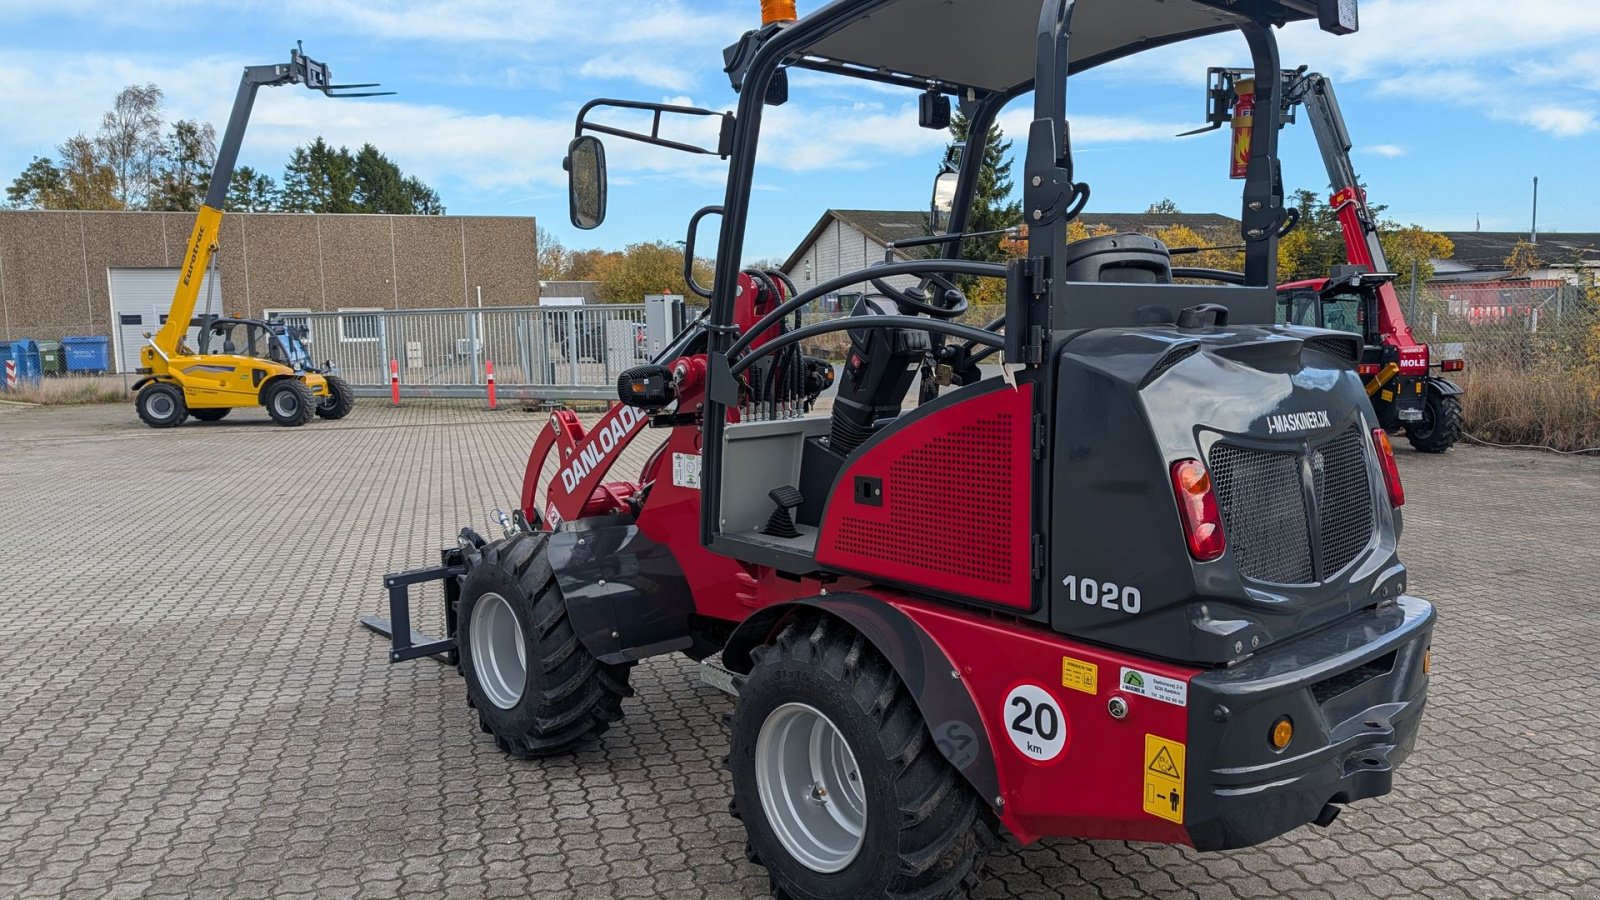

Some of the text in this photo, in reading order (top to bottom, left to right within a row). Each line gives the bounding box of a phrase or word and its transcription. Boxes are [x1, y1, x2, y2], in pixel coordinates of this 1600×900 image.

[183, 225, 204, 286] Eurotrac
[1401, 359, 1426, 367] MOLE
[1266, 410, 1331, 434] J-MASKINER.DK
[561, 404, 647, 495] DANLOADE
[1062, 575, 1140, 614] 1020
[1011, 696, 1058, 741] 20
[1027, 741, 1042, 755] km
